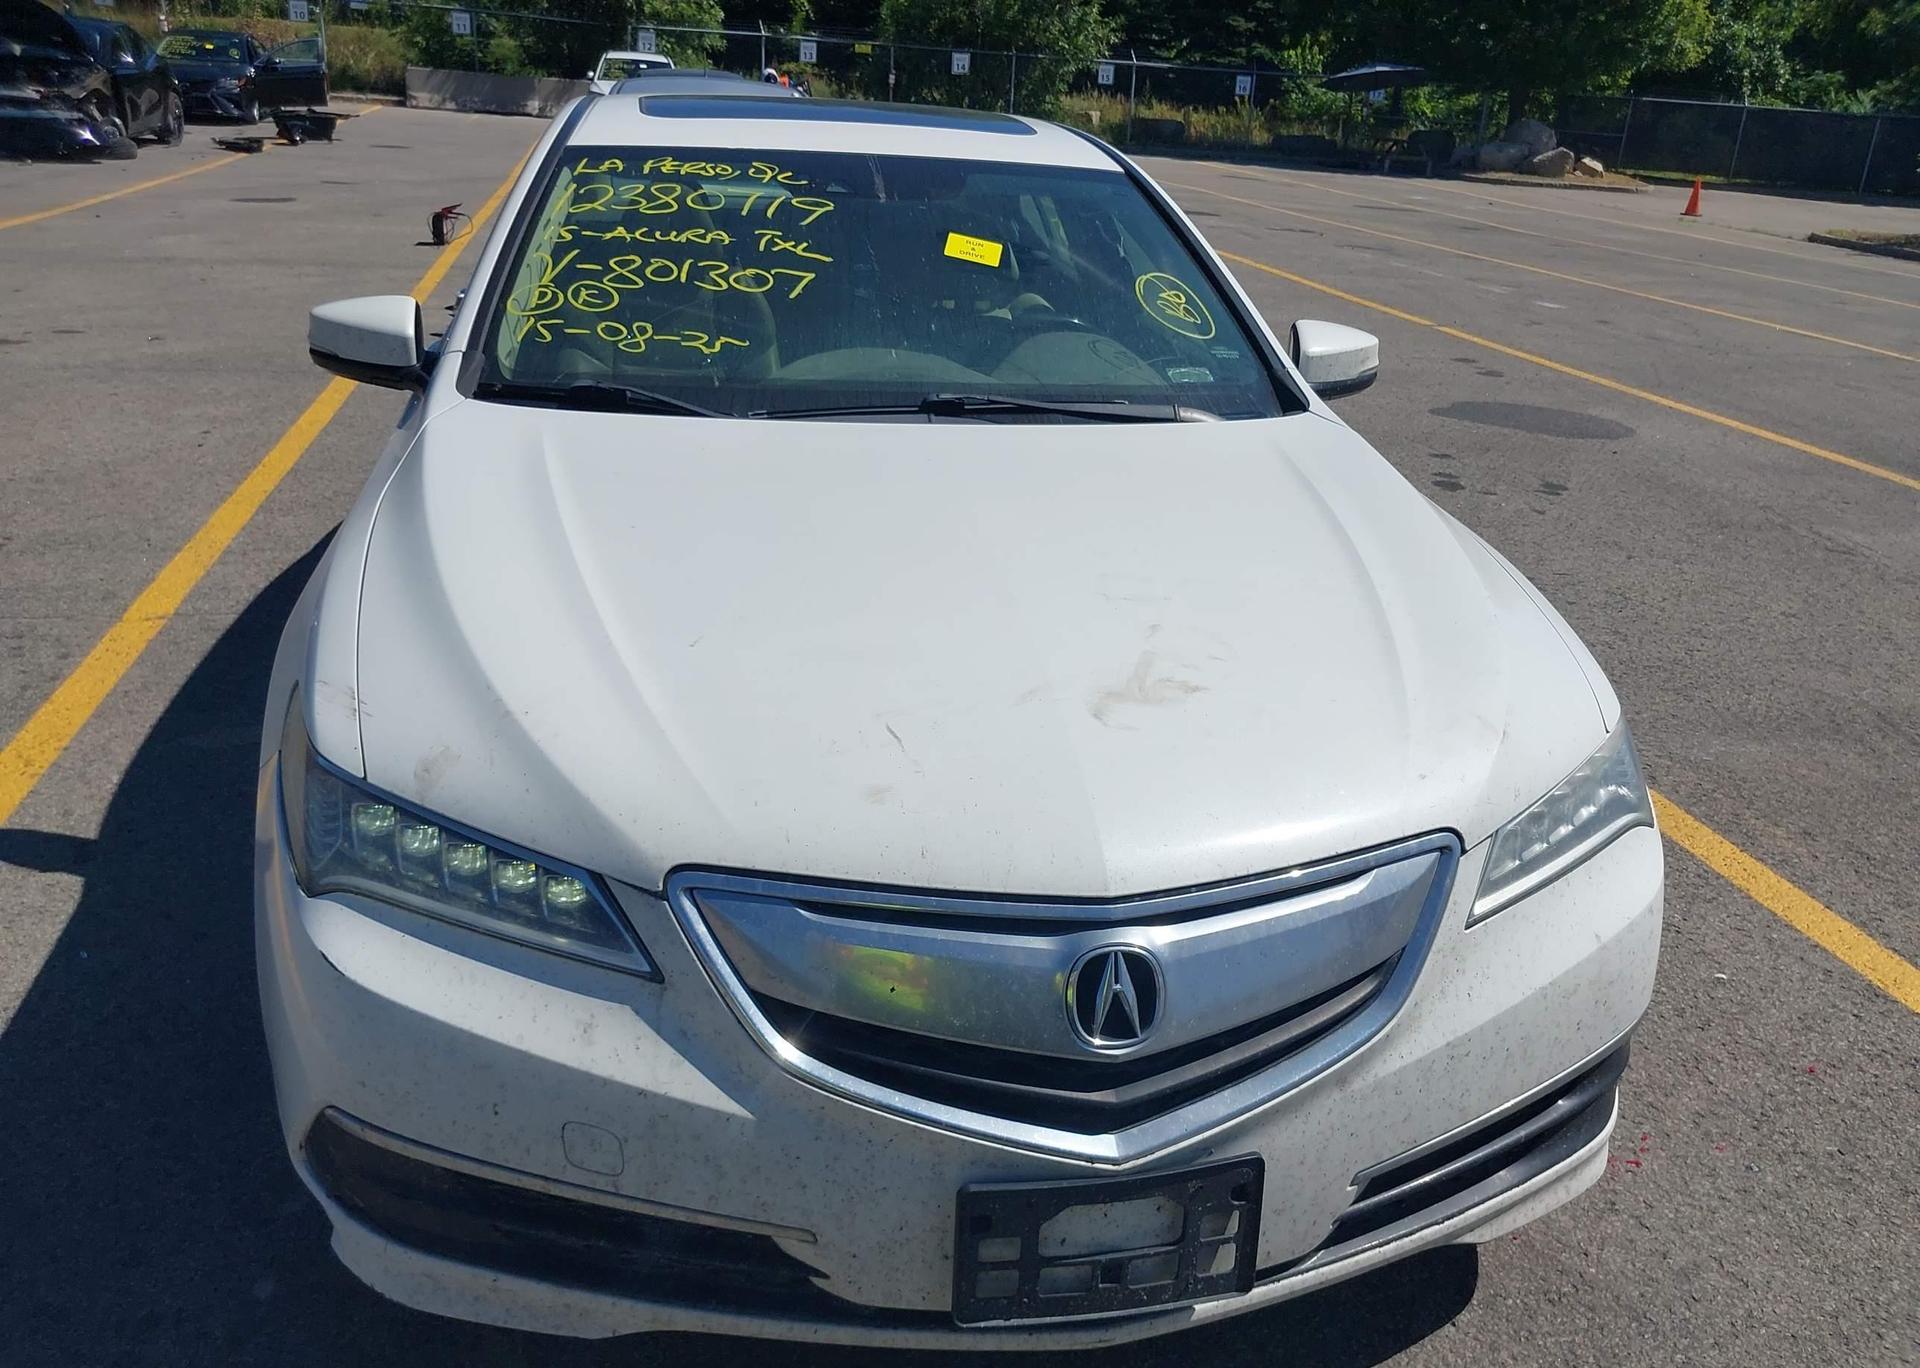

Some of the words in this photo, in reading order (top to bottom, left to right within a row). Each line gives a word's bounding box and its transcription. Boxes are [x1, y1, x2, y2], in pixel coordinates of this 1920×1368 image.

[293, 10, 306, 20] 10
[456, 23, 467, 31] 11
[641, 42, 653, 51] 12
[803, 51, 813, 60] 13
[956, 63, 966, 71] 14
[1101, 74, 1110, 82] 15
[573, 158, 625, 177] LA
[965, 239, 984, 248] RUN
[959, 250, 985, 260] DRIVE
[533, 248, 817, 299] V-801307
